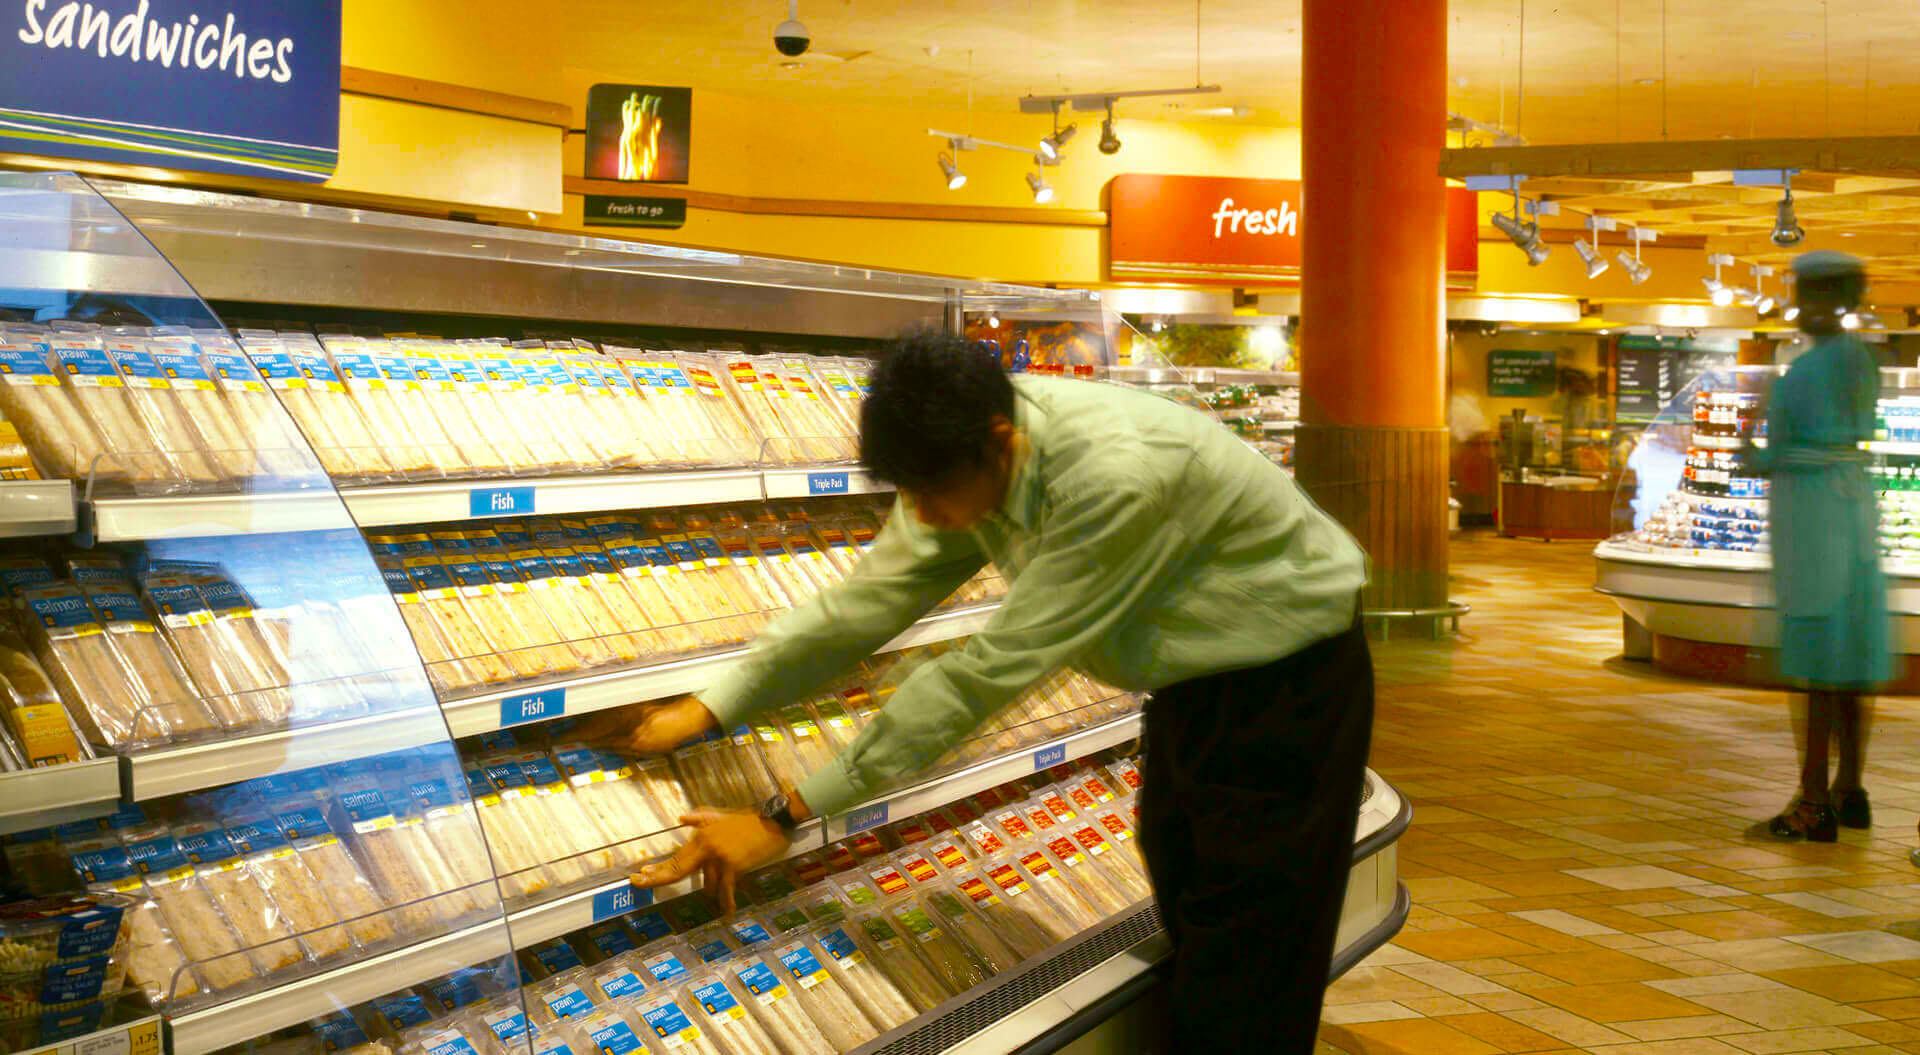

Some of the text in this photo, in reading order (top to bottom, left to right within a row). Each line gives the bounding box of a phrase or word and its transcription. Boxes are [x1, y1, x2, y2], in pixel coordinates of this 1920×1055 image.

[18, 0, 294, 83] sandwiches
[607, 202, 663, 217] fresh to go
[1213, 198, 1297, 237] fresh
[57, 350, 89, 361] prawn
[815, 478, 843, 491] Triple Pack
[491, 492, 514, 511] Fish
[94, 593, 137, 608] salmon
[154, 588, 193, 601] salmon
[35, 598, 81, 614] salmon
[521, 697, 545, 717] Fish
[343, 790, 381, 808] salmon
[281, 813, 306, 828] tuna
[230, 825, 260, 842] tuna
[181, 835, 209, 850] tuna
[130, 843, 158, 859] tuna
[74, 852, 105, 868] tuna
[613, 888, 635, 911] Fish
[604, 978, 628, 995] prawn
[551, 996, 575, 1012] prawn
[645, 1007, 669, 1025] prawn
[492, 1019, 517, 1034] prawn
[593, 1027, 617, 1046] prawn
